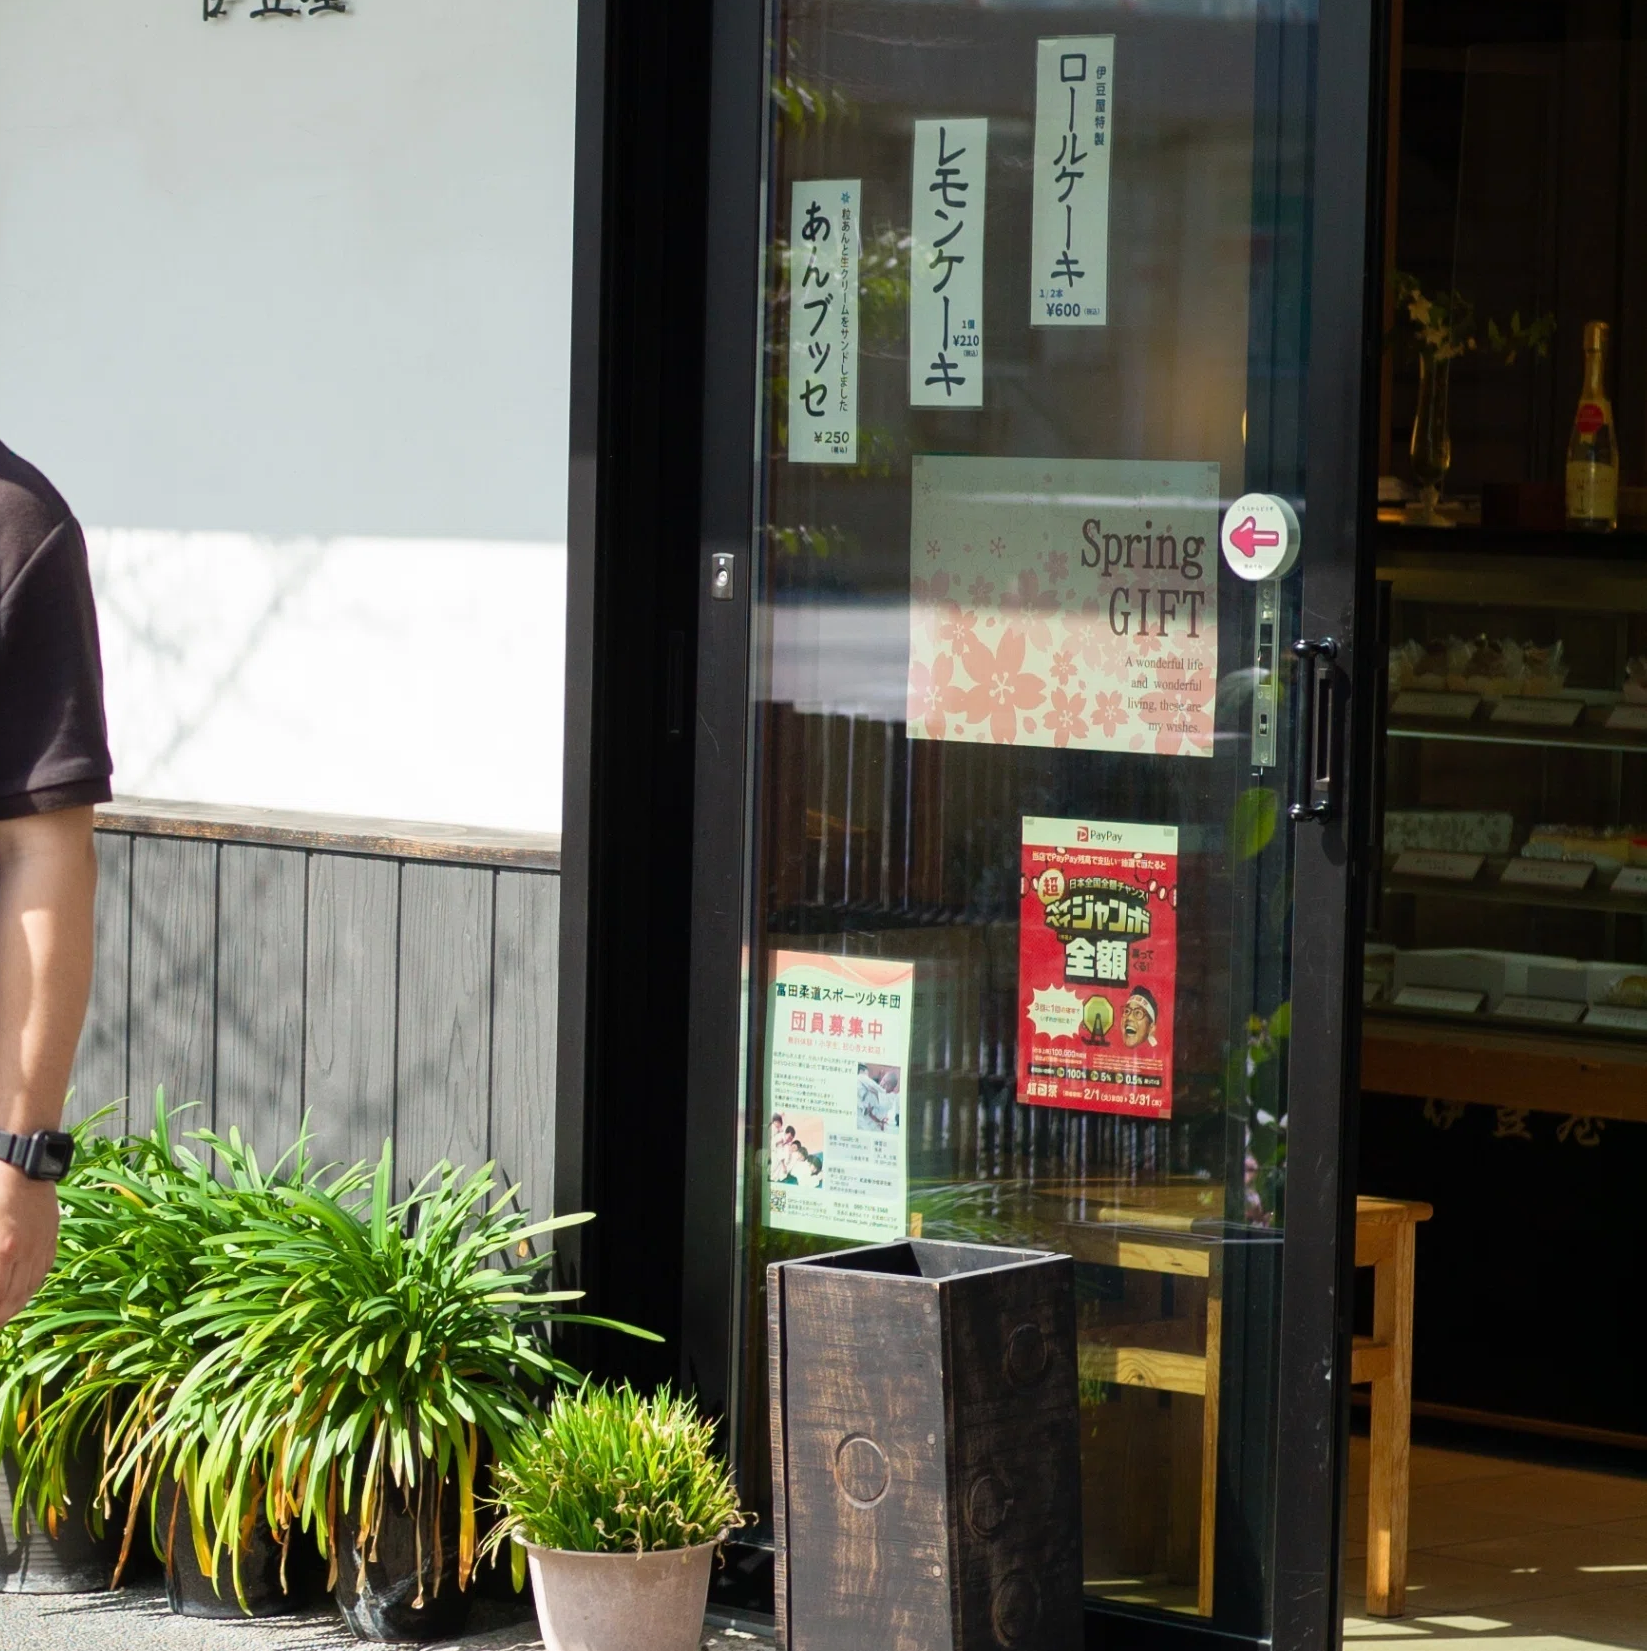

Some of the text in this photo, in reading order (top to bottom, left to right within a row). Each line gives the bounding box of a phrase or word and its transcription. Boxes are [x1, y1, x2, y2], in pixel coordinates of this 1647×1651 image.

[1094, 66, 1107, 146] 伊豆屋特製
[1050, 53, 1088, 288] ロールケーキ
[925, 126, 969, 396] レモンケーキ
[799, 201, 834, 418] あんブッセ
[1047, 303, 1081, 317] ¥600
[953, 335, 980, 347] ¥210
[814, 431, 850, 445] ¥250
[1081, 518, 1205, 580] Spring
[1109, 587, 1205, 638] GIFT
[1125, 657, 1204, 670] A wonderful life
[1131, 678, 1202, 692] and wonderful
[1128, 697, 1202, 712] living, these are
[1148, 720, 1201, 734] my wishes.
[1090, 829, 1123, 843] PayPay
[1043, 876, 1059, 897] 超
[1066, 937, 1128, 980] 全額
[776, 982, 900, 1009] 富田柔道スポーツ少年団
[791, 1010, 883, 1041] 団員募集中
